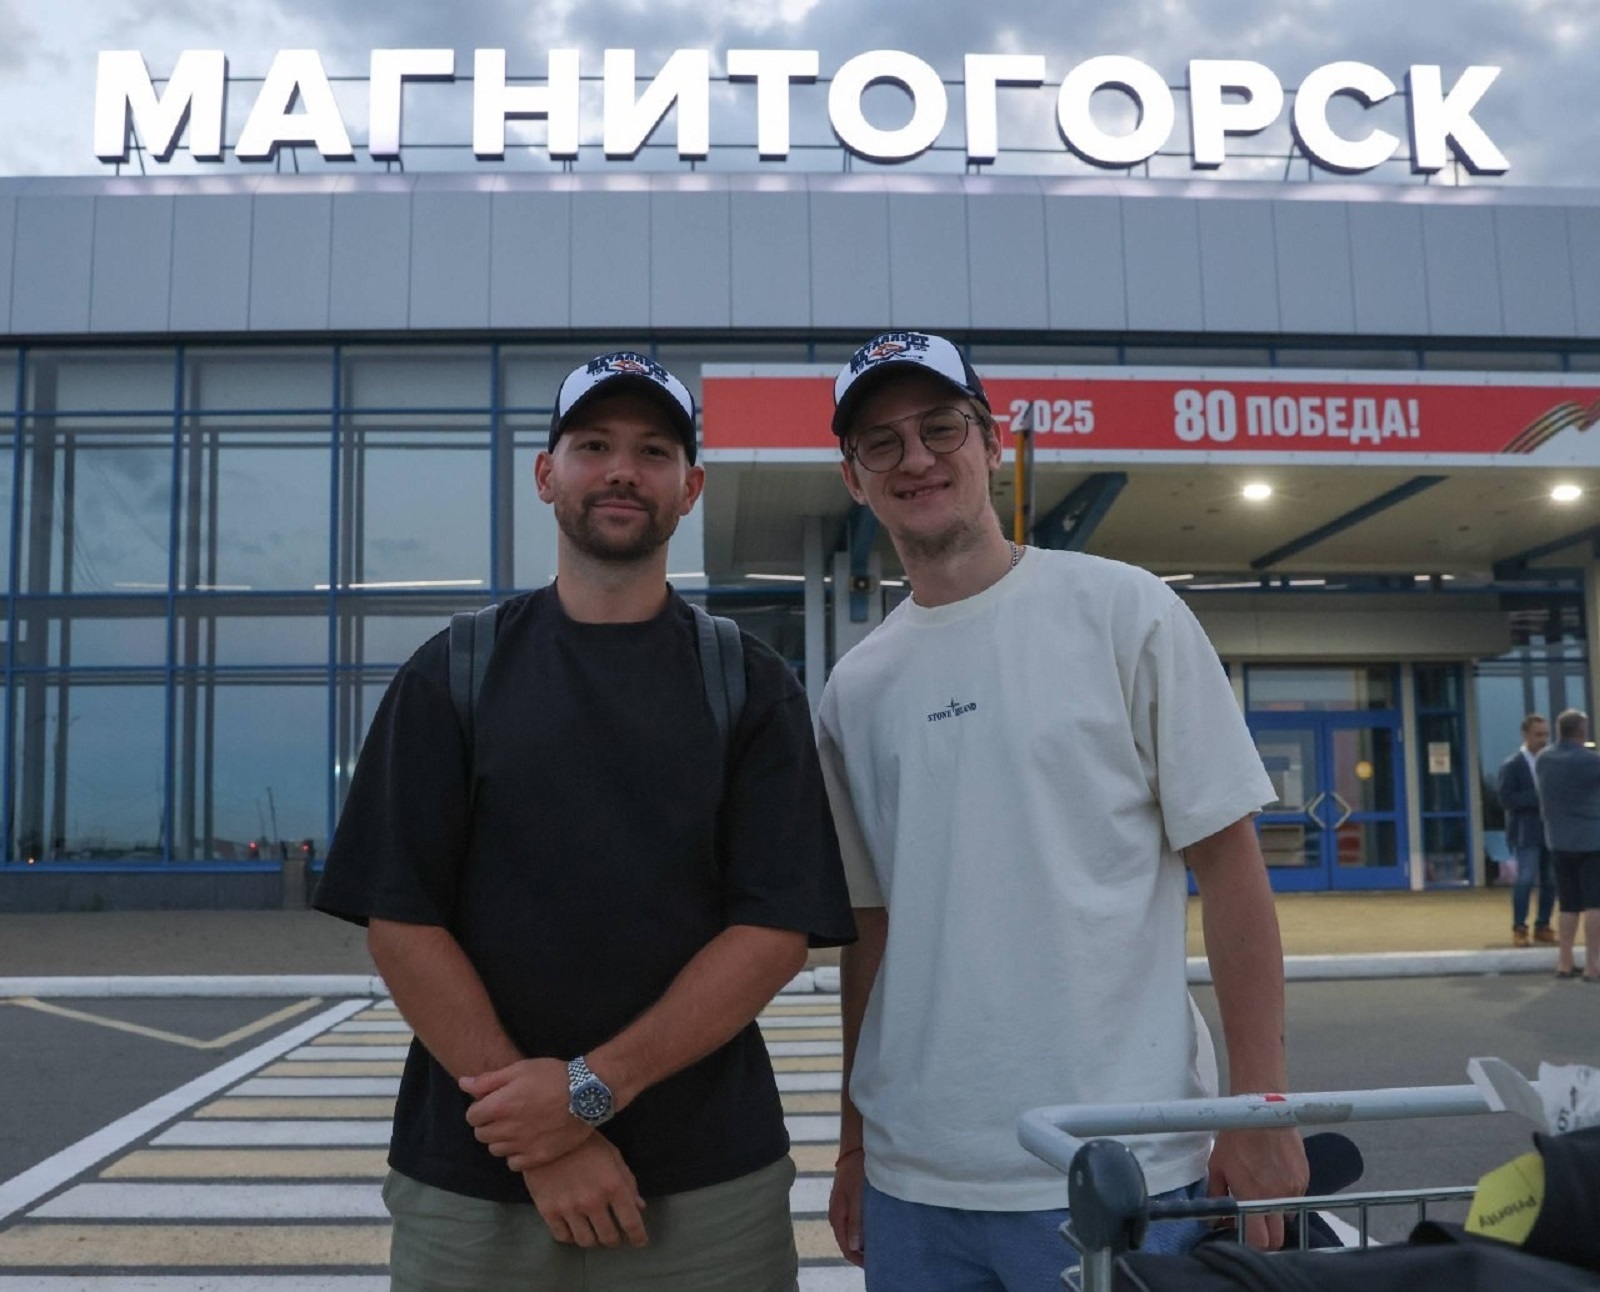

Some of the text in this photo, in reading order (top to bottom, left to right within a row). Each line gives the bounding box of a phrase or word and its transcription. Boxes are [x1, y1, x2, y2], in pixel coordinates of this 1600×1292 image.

[94, 48, 1510, 175] МАГНИТОГОРСК
[1173, 389, 1239, 442] 80
[1245, 396, 1421, 445] ПОБЕДА!
[927, 709, 952, 722] STONE
[1479, 1195, 1538, 1230] Priority
